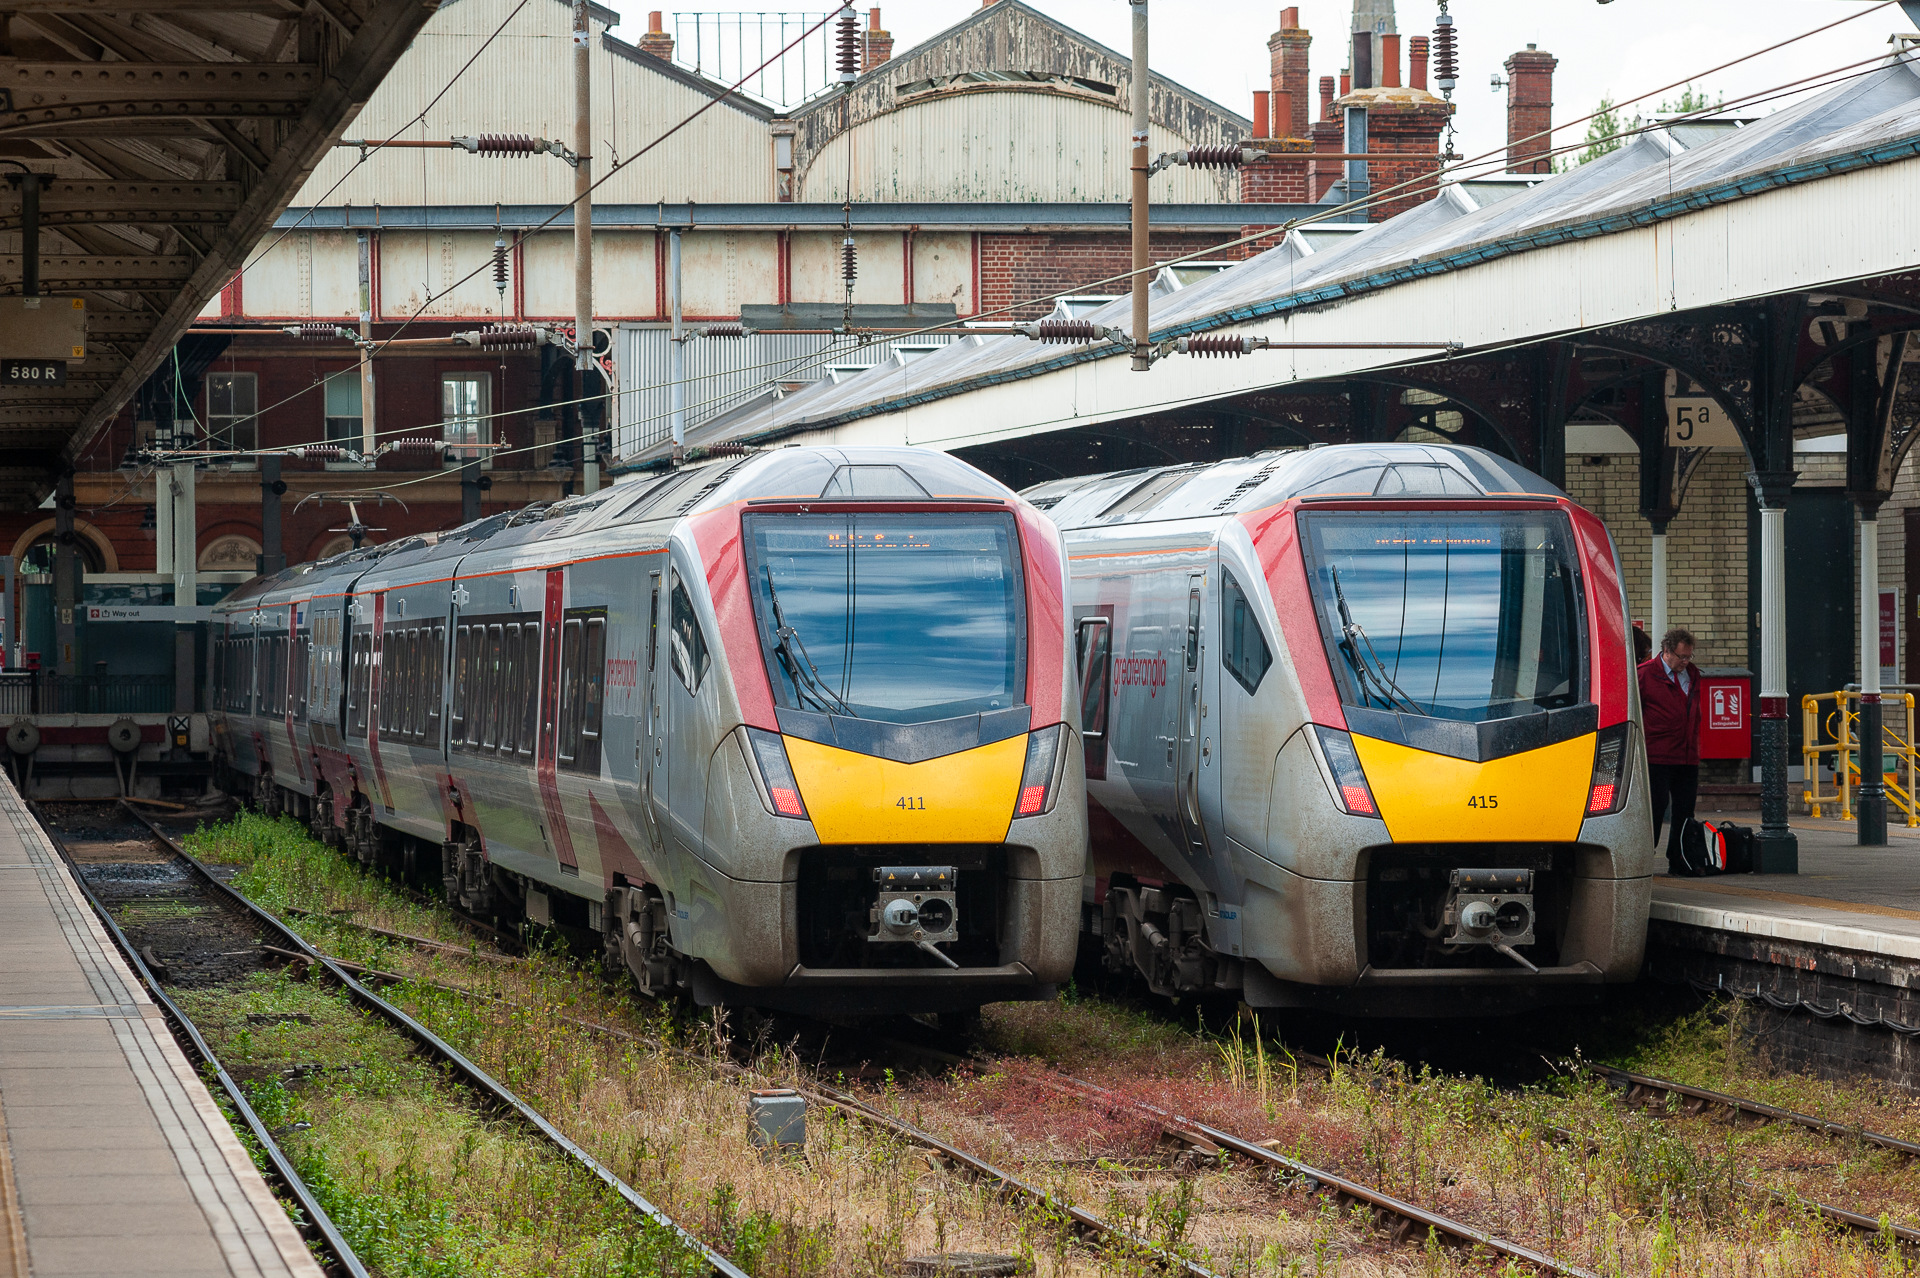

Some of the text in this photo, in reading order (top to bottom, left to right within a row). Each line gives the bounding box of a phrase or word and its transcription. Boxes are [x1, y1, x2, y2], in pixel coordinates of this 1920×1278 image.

[11, 366, 56, 380] 580 R
[112, 610, 127, 618] Way
[1113, 649, 1167, 699] greateranglia
[895, 796, 926, 810] 411
[1467, 795, 1498, 809] 415
